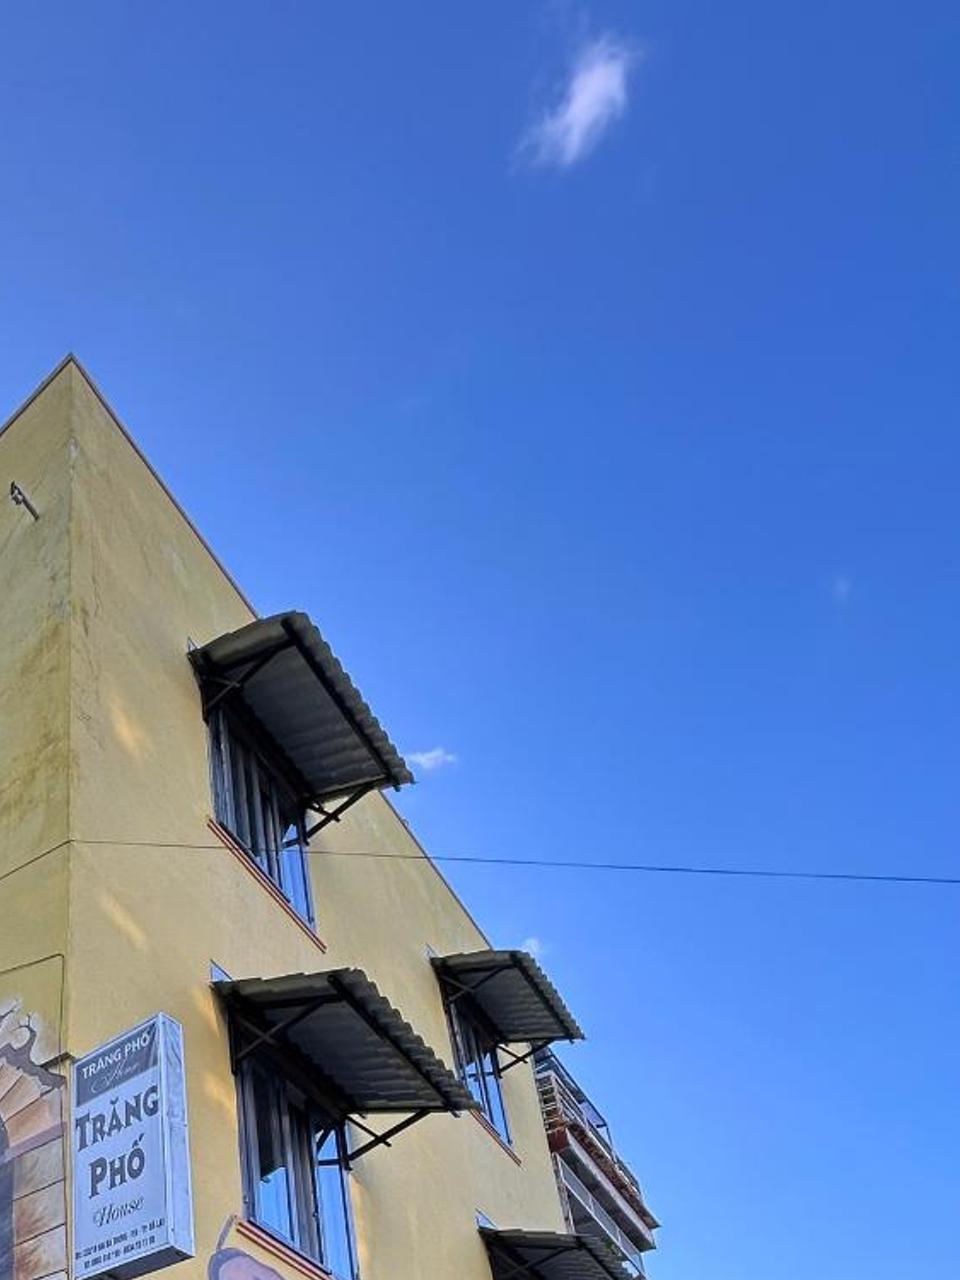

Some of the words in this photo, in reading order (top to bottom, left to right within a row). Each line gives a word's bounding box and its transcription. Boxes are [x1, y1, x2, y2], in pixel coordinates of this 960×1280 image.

[75, 1084, 159, 1153] TRĂNG
[88, 1132, 146, 1200] PHỐ
[92, 1196, 144, 1228] House
